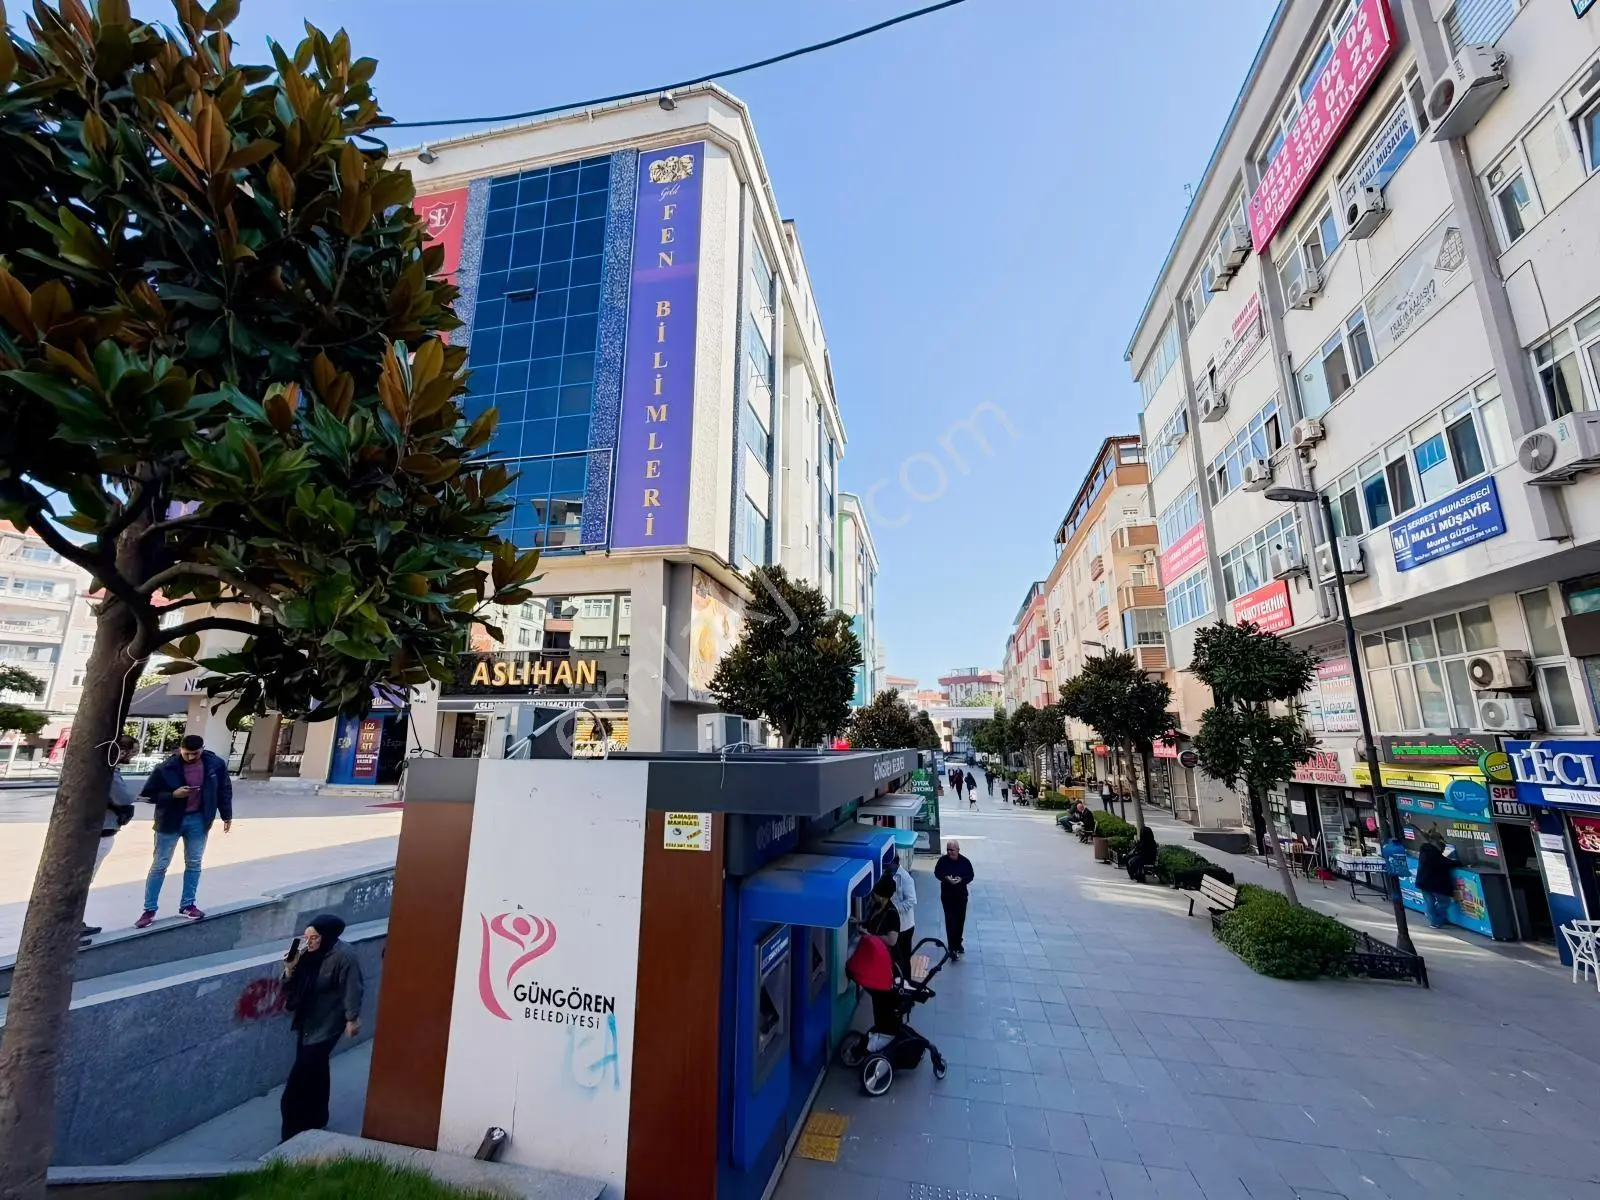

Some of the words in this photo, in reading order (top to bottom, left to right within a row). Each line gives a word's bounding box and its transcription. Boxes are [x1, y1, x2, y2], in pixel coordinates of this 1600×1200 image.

[1261, 144, 1289, 197] 0212
[1292, 94, 1317, 143] 555
[1321, 56, 1341, 92] 06
[1345, 9, 1368, 49] 06
[1264, 163, 1291, 214] 0539
[1295, 113, 1321, 161] 335
[1325, 73, 1345, 111] 04
[1350, 27, 1373, 71] 24
[658, 203, 677, 269] FEN
[643, 299, 672, 537] BİLİMLERİ
[1439, 484, 1490, 517] MUHASEBECİ
[1411, 522, 1437, 544] MALİ
[1438, 501, 1492, 531] MÜŞAVİR
[1426, 537, 1449, 549] Murat
[1449, 523, 1478, 540] GÜZEL
[470, 659, 598, 686] ASLIHAN
[1495, 801, 1527, 815] TOTO
[513, 981, 616, 1014] GÜNGÖREN
[524, 1007, 600, 1029] BELEDİYESİ
